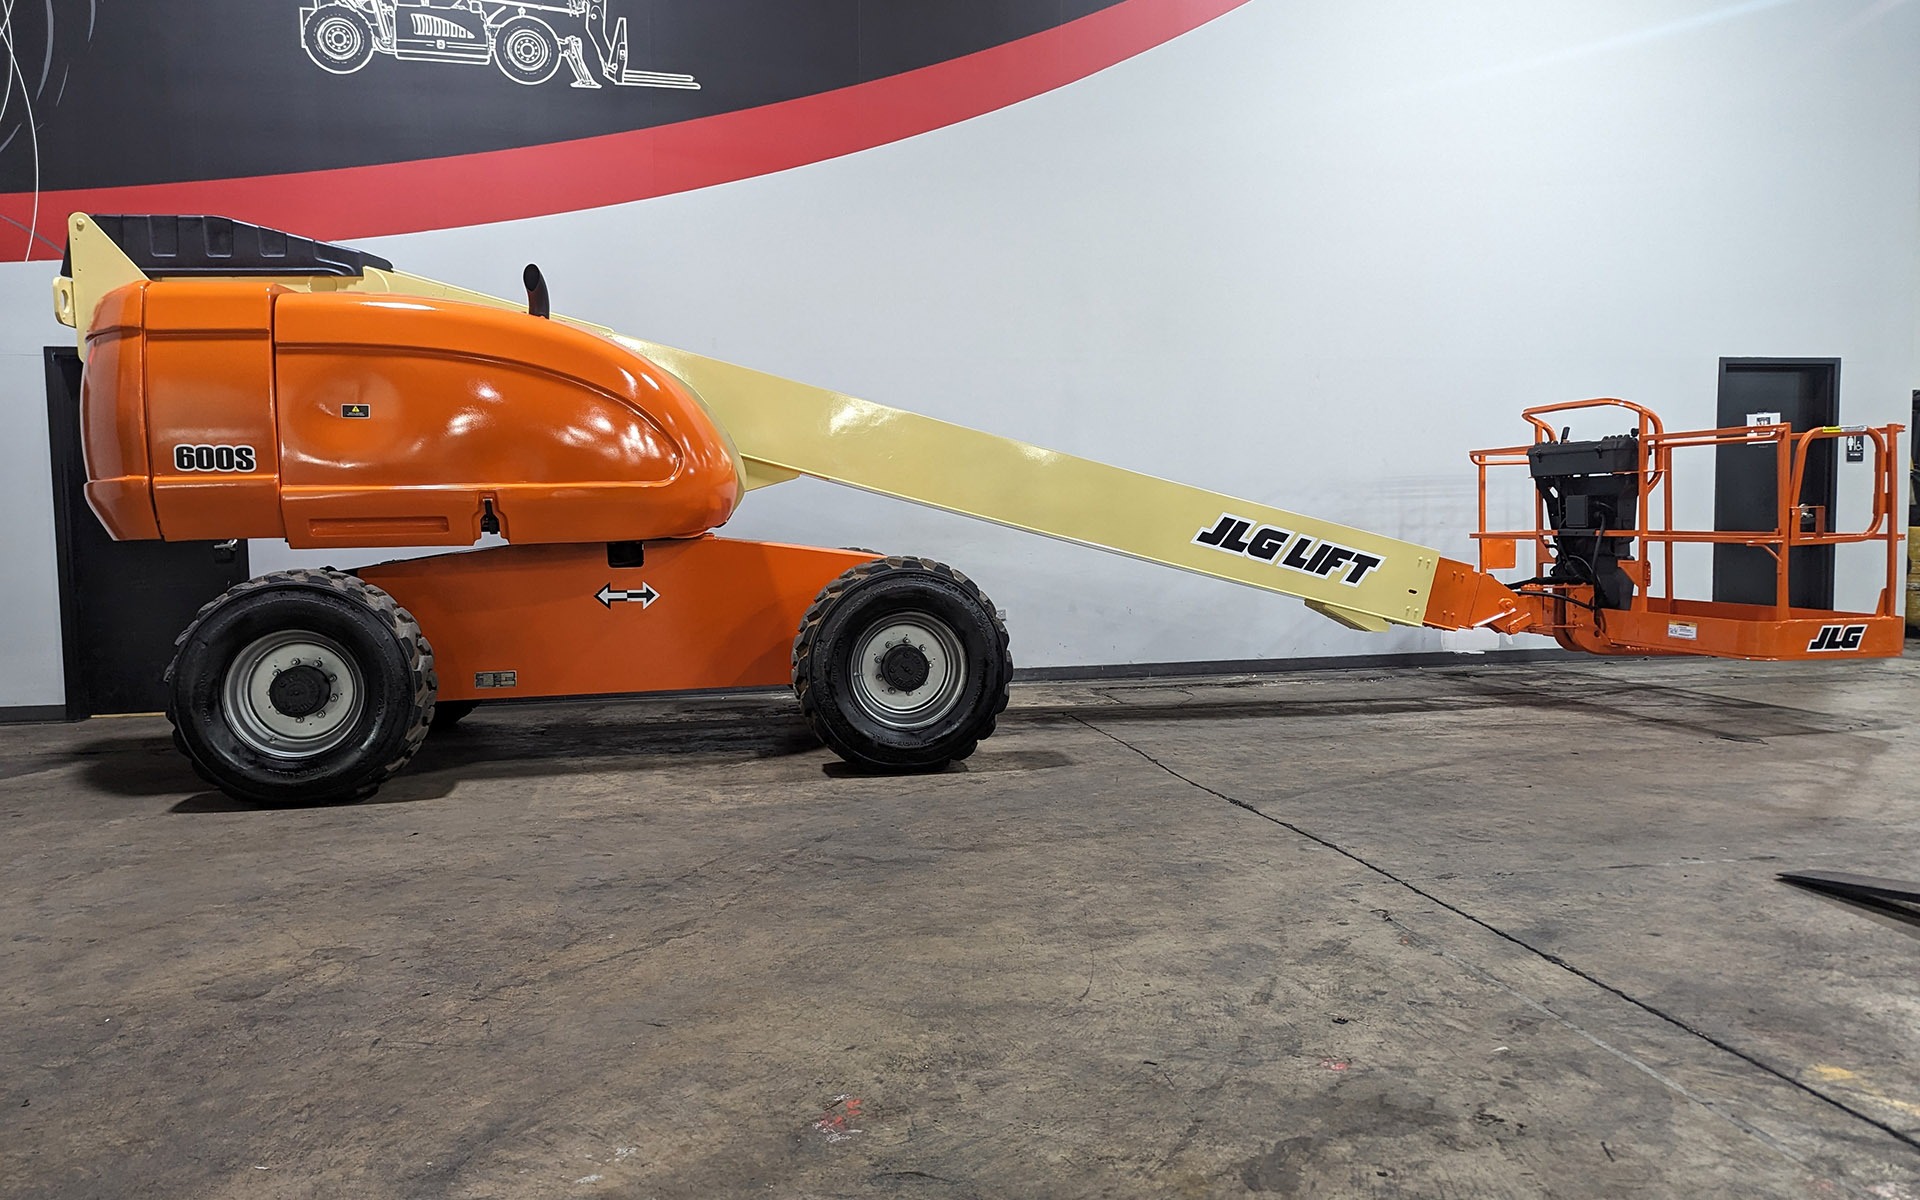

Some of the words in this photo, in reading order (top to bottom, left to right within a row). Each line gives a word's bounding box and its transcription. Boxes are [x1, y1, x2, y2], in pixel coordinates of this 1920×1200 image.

[175, 446, 255, 471] 600S
[1195, 515, 1291, 562] JLG
[1281, 536, 1382, 585] LIFT
[1808, 626, 1865, 650] JLG
